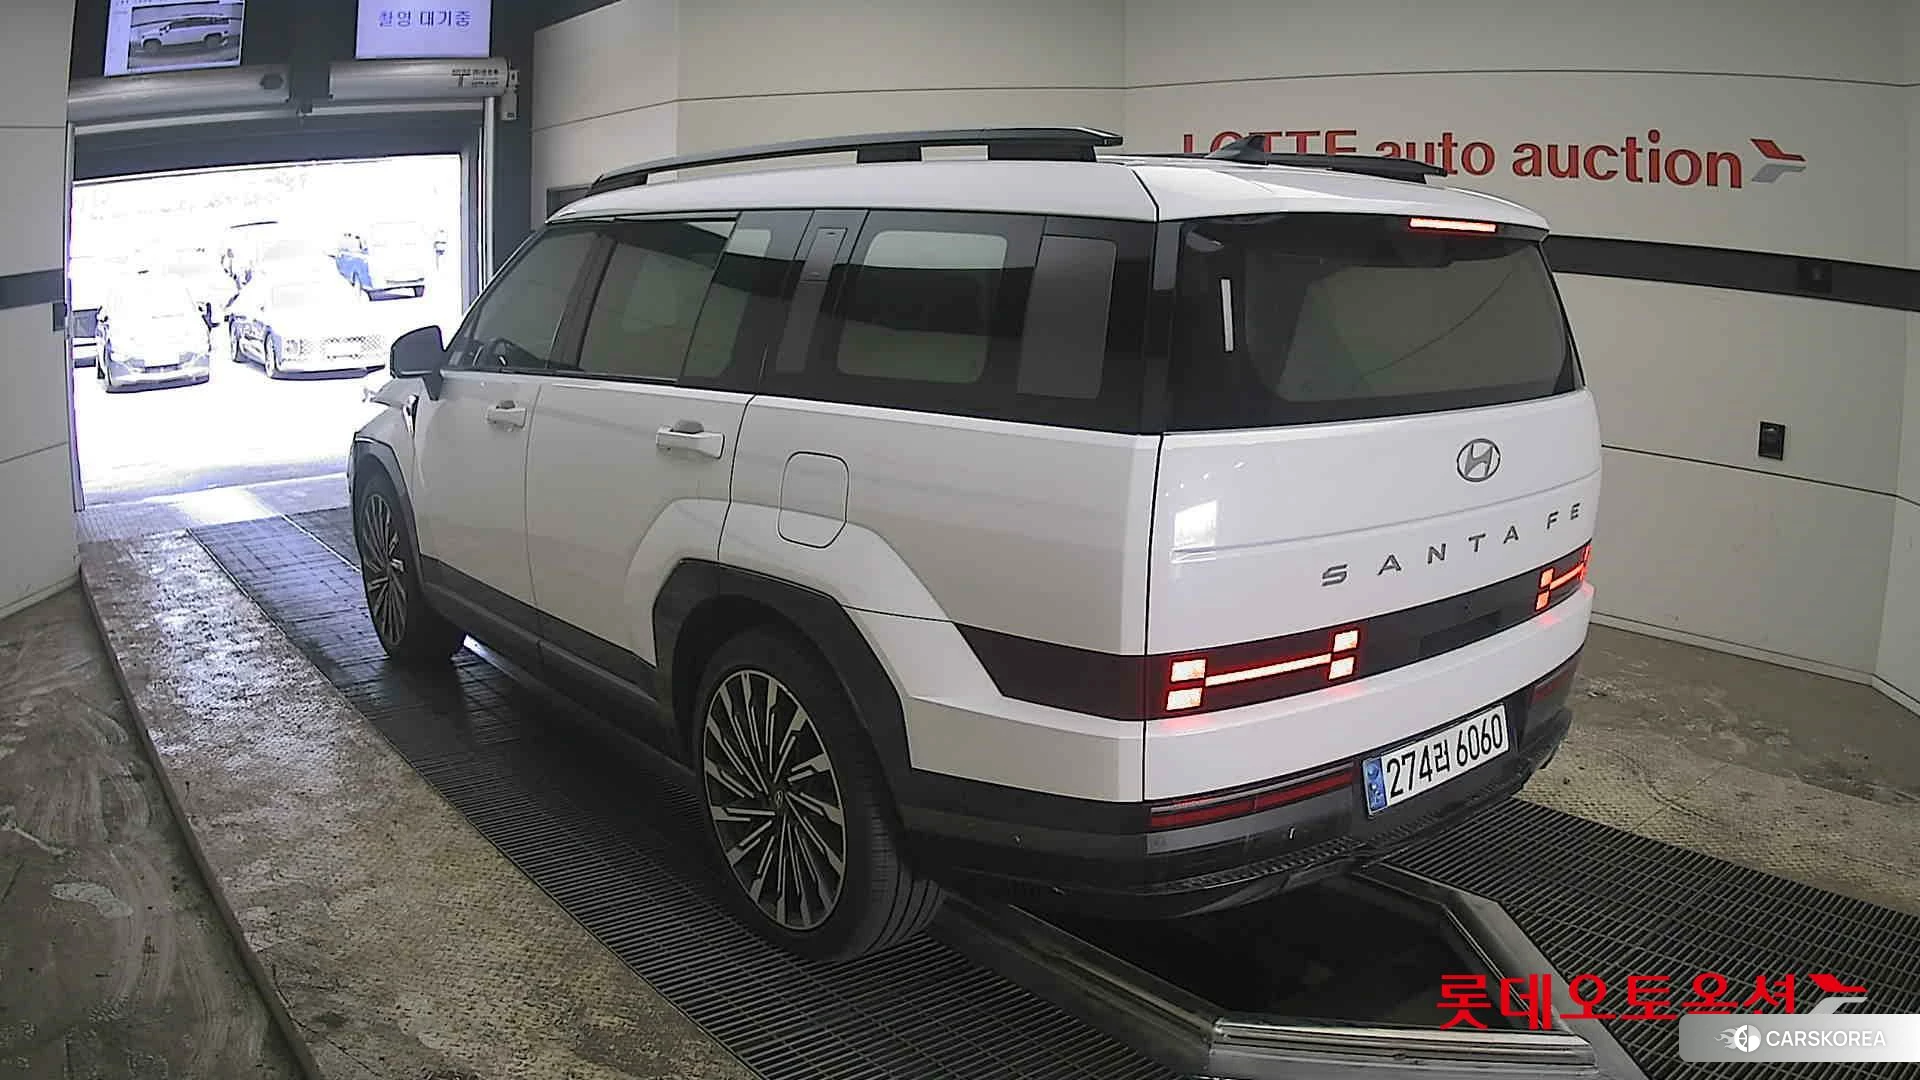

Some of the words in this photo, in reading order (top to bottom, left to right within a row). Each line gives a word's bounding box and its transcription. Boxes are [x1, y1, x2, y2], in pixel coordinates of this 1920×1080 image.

[420, 10, 472, 27] 대기중
[1512, 129, 1742, 188] auction
[1321, 525, 1520, 587] SANTA
[1546, 503, 1581, 531] FE
[1386, 739, 1451, 799] 274러
[1457, 714, 1503, 767] 6060
